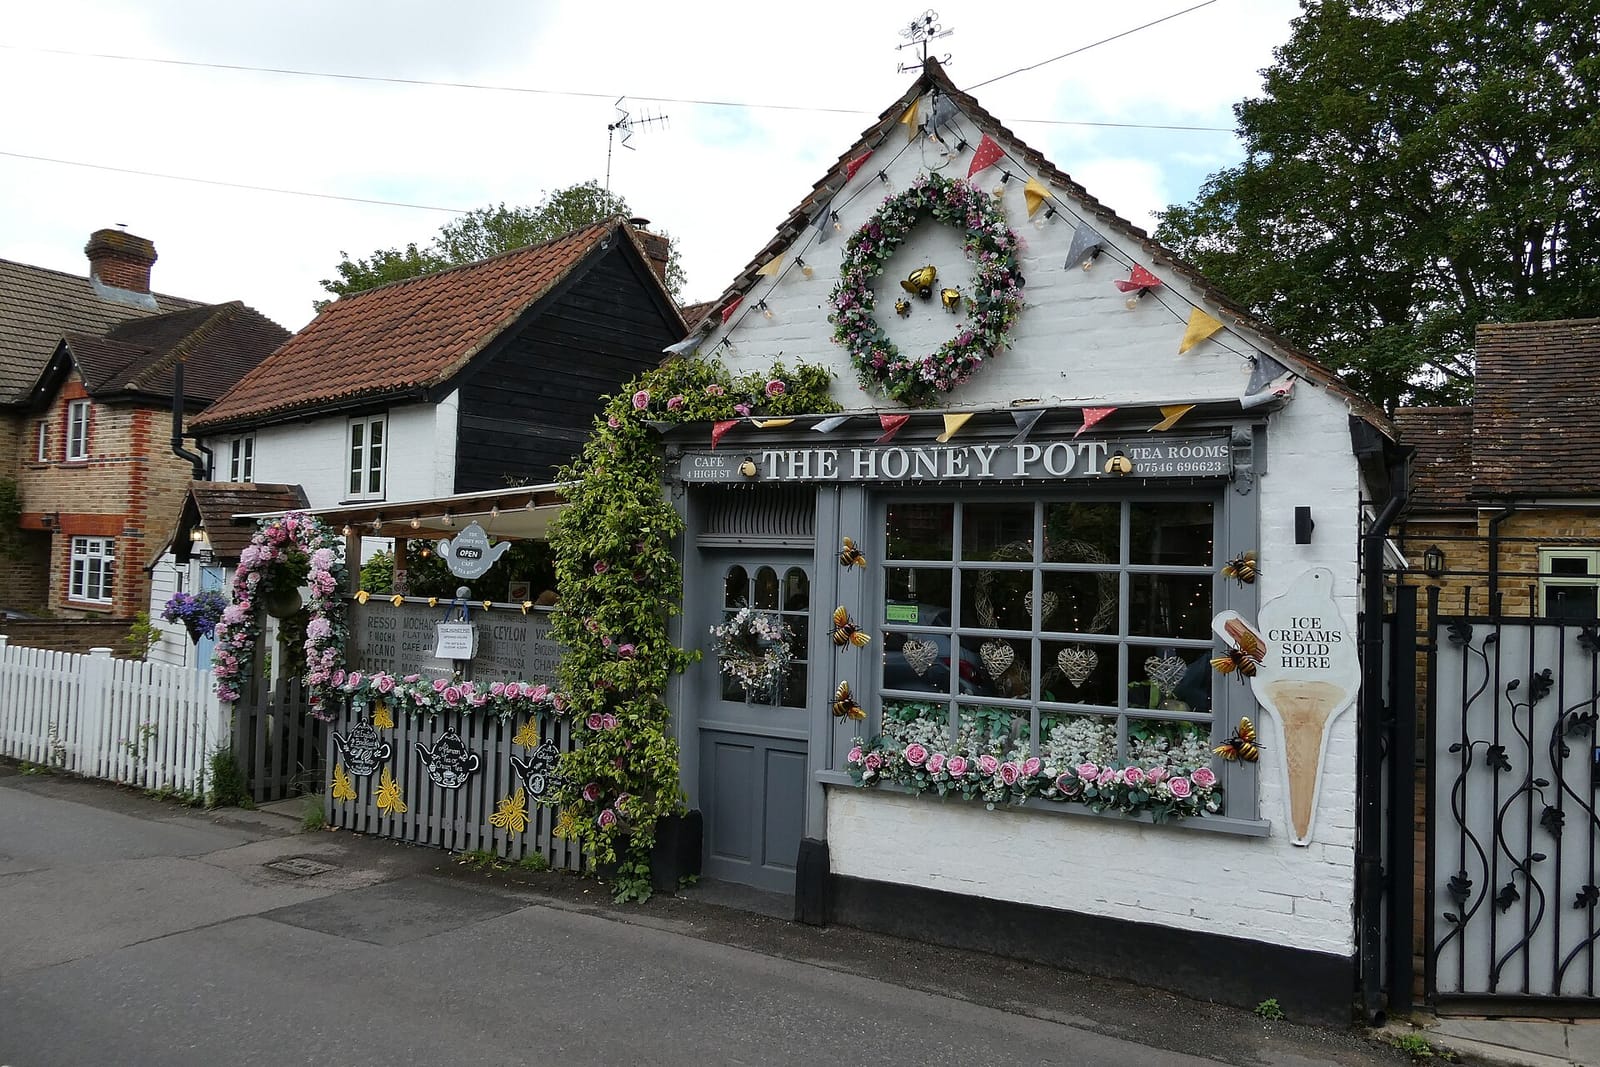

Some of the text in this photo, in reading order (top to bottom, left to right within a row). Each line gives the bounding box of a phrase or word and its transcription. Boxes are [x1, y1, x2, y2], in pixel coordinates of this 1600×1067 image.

[1129, 445, 1229, 460] TEA ROOMS
[694, 455, 725, 468] CAFÉ
[762, 441, 1108, 480] THE HONEY POT
[1137, 461, 1222, 473] 07546 696623
[686, 469, 731, 479] 4 HIGH ST
[459, 549, 479, 558] OPEN
[1291, 617, 1322, 629] ICE
[494, 625, 527, 642] CEYLON
[1268, 629, 1342, 642] CREAMS
[1282, 643, 1330, 655] SOLD
[1281, 656, 1331, 669] HERE
